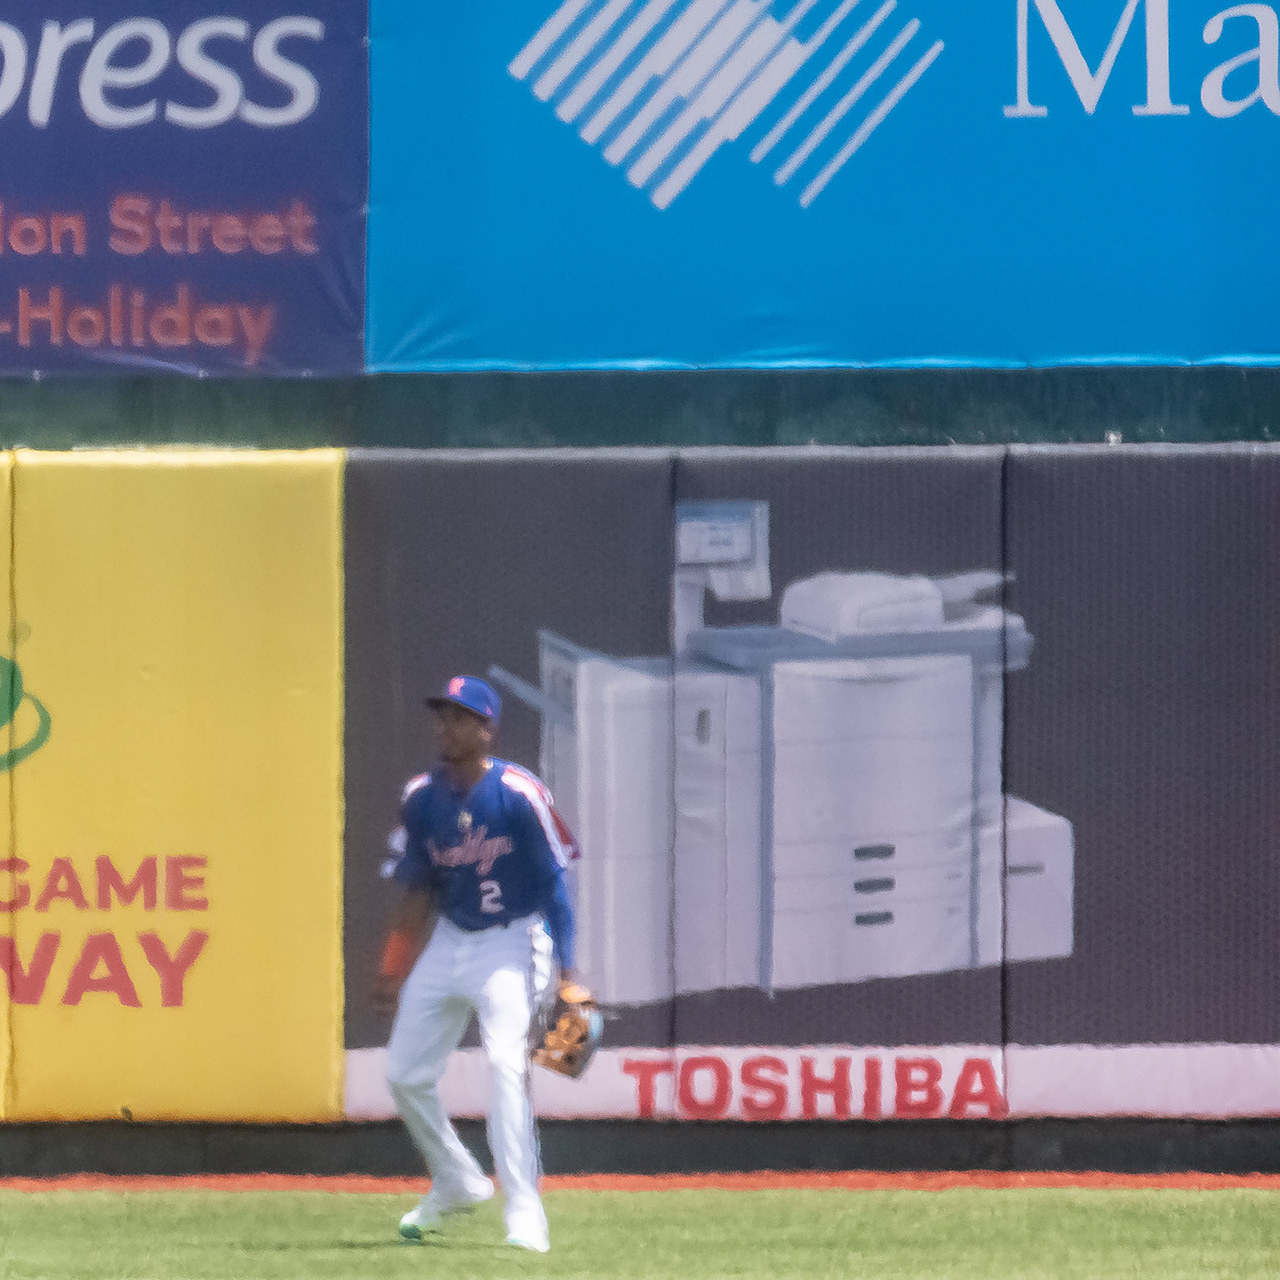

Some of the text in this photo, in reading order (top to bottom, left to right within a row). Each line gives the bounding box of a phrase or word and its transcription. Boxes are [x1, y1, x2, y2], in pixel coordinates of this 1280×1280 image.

[107, 193, 317, 256] Street
[479, 878, 505, 915] 2
[623, 1055, 1009, 1121] TOSHIBA
